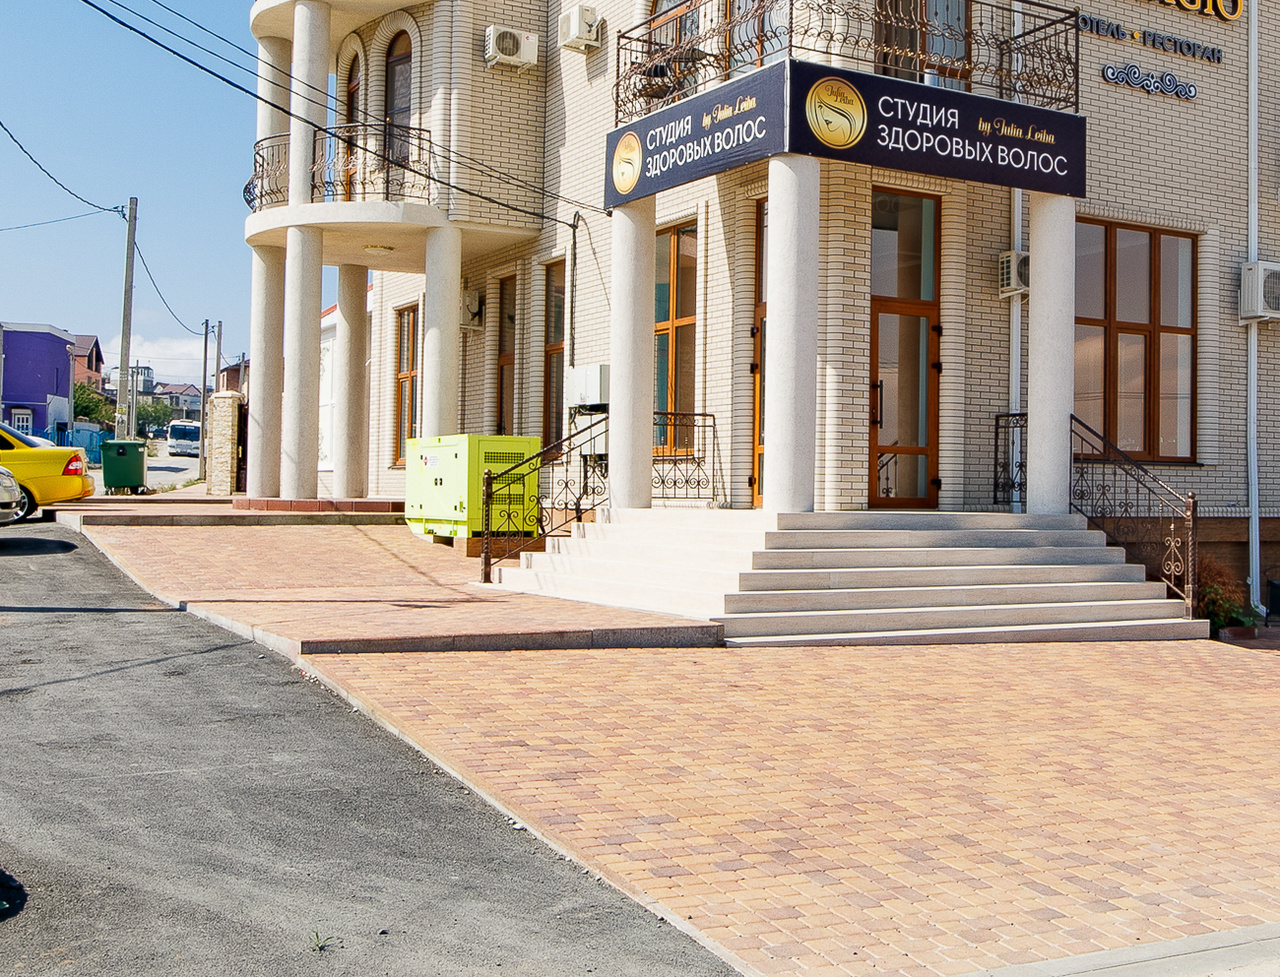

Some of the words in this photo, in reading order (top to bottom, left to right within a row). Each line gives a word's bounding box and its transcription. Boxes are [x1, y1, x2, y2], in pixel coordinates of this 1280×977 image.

[1078, 14, 1127, 41] ОТЕЛЬ
[1144, 30, 1223, 64] РЕСТОРАН
[646, 115, 692, 150] СТУДИЯ
[877, 96, 959, 129] СТУДИЯ
[978, 117, 992, 137] by
[993, 117, 1023, 138] Julia
[645, 133, 713, 178] ЗДОРОВЫХ
[715, 116, 767, 155] ВОЛОС
[877, 124, 993, 164] ЗДОРОВЫХ
[998, 145, 1068, 176] ВОЛОС
